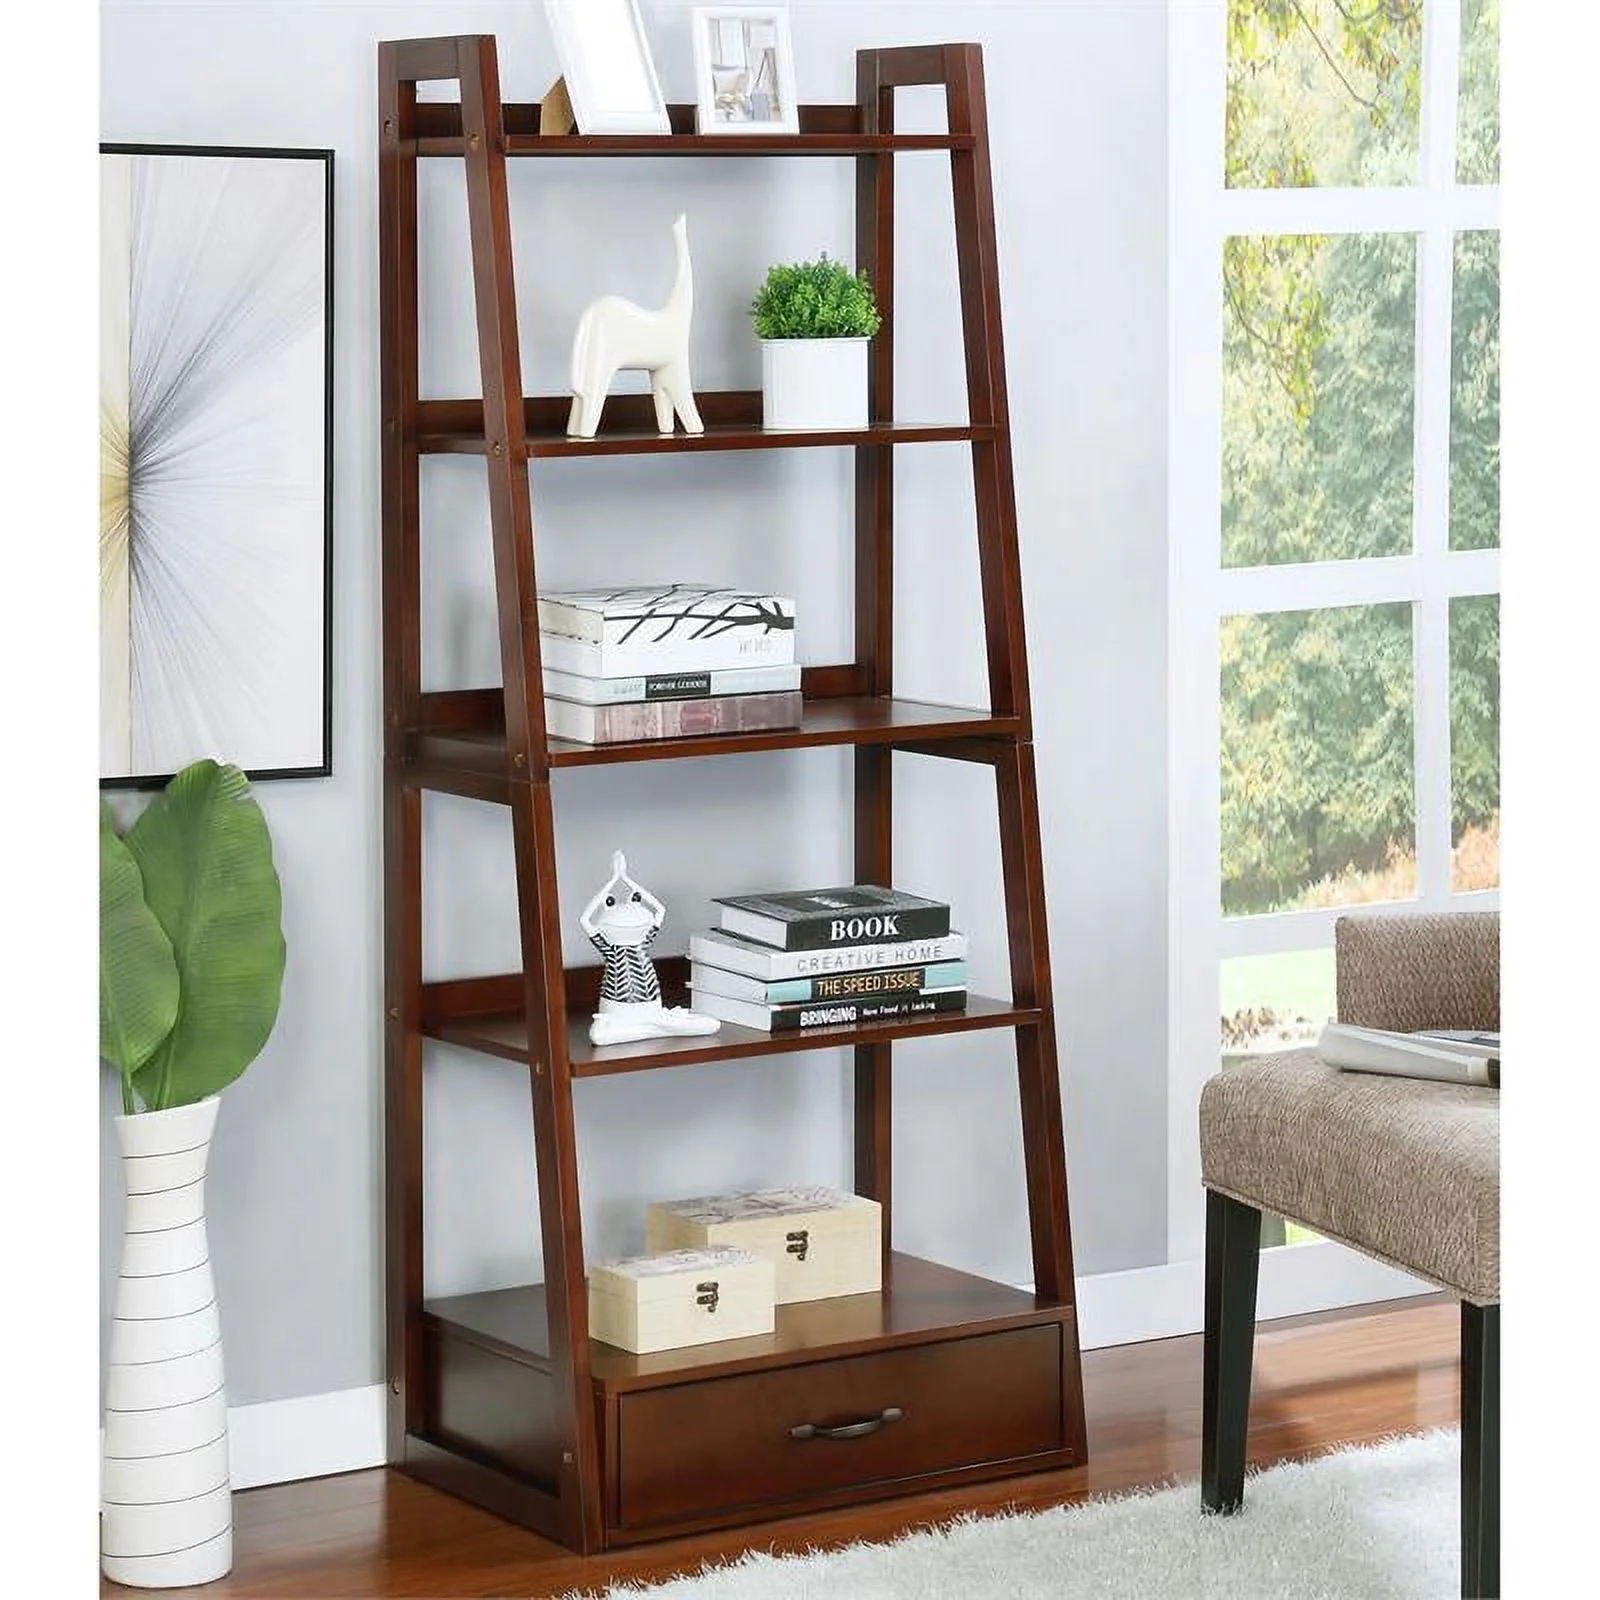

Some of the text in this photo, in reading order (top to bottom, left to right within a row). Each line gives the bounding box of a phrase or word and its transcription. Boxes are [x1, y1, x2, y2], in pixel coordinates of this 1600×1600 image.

[831, 914, 900, 941] BOOK
[797, 944, 942, 971] CREATIVE HOME
[817, 974, 921, 996] THE SPEED ISSUE
[800, 1006, 857, 1027] BRINGING
